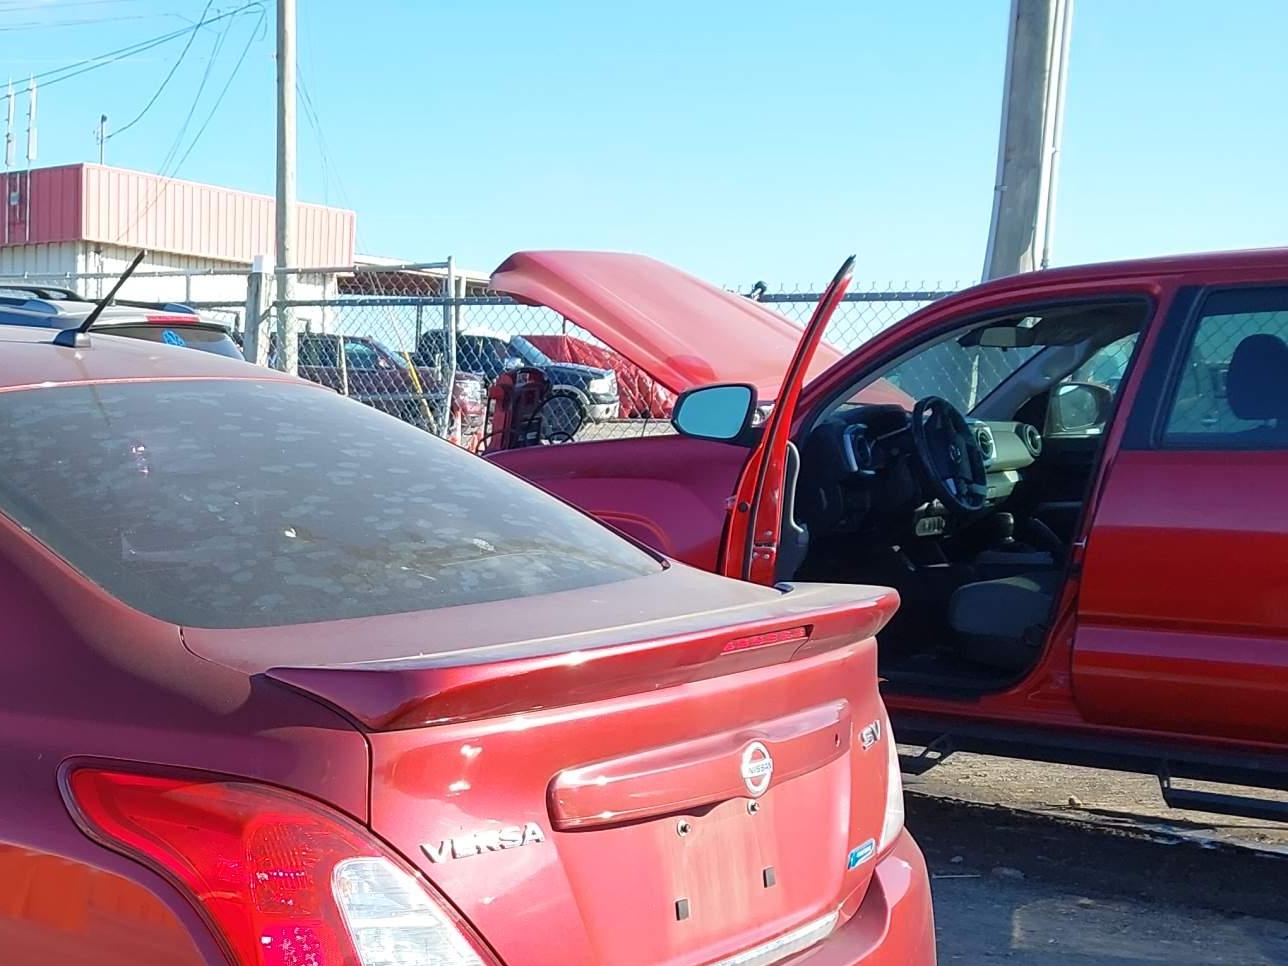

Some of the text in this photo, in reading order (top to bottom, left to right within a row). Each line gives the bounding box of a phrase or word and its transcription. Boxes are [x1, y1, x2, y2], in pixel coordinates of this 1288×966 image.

[860, 719, 881, 751] SV
[748, 761, 772, 774] NISSAN
[418, 822, 546, 864] VERSA
